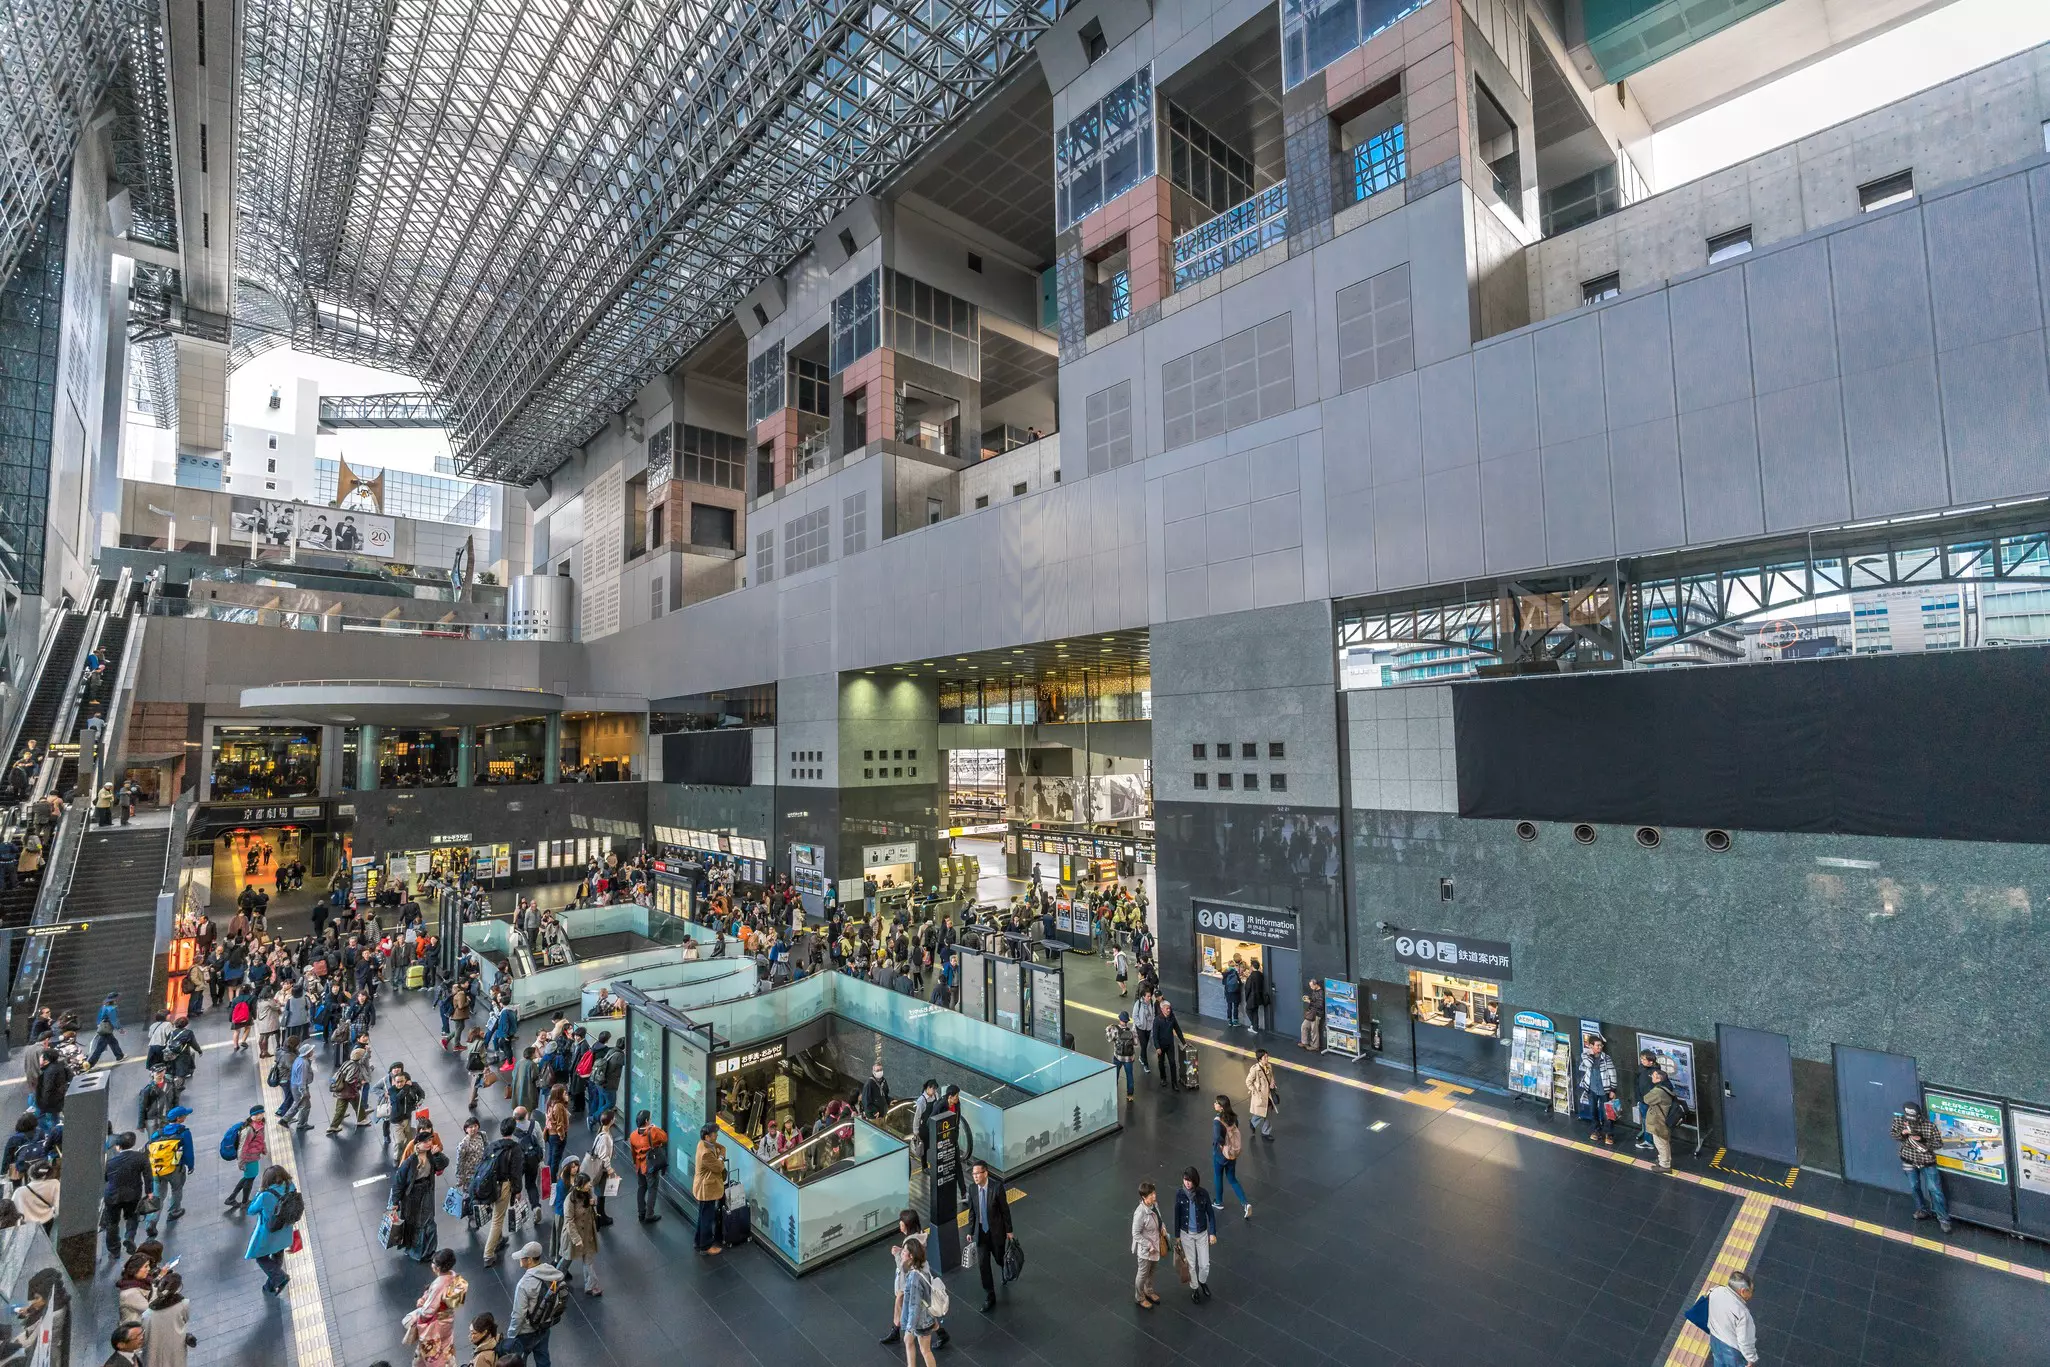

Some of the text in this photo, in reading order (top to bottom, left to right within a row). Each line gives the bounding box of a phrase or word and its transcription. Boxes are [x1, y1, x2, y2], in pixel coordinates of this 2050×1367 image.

[371, 531, 387, 542] 20
[243, 807, 288, 820] 京都劇場
[1246, 915, 1295, 930] JR Information
[1458, 949, 1509, 967] 鉄道案内所
